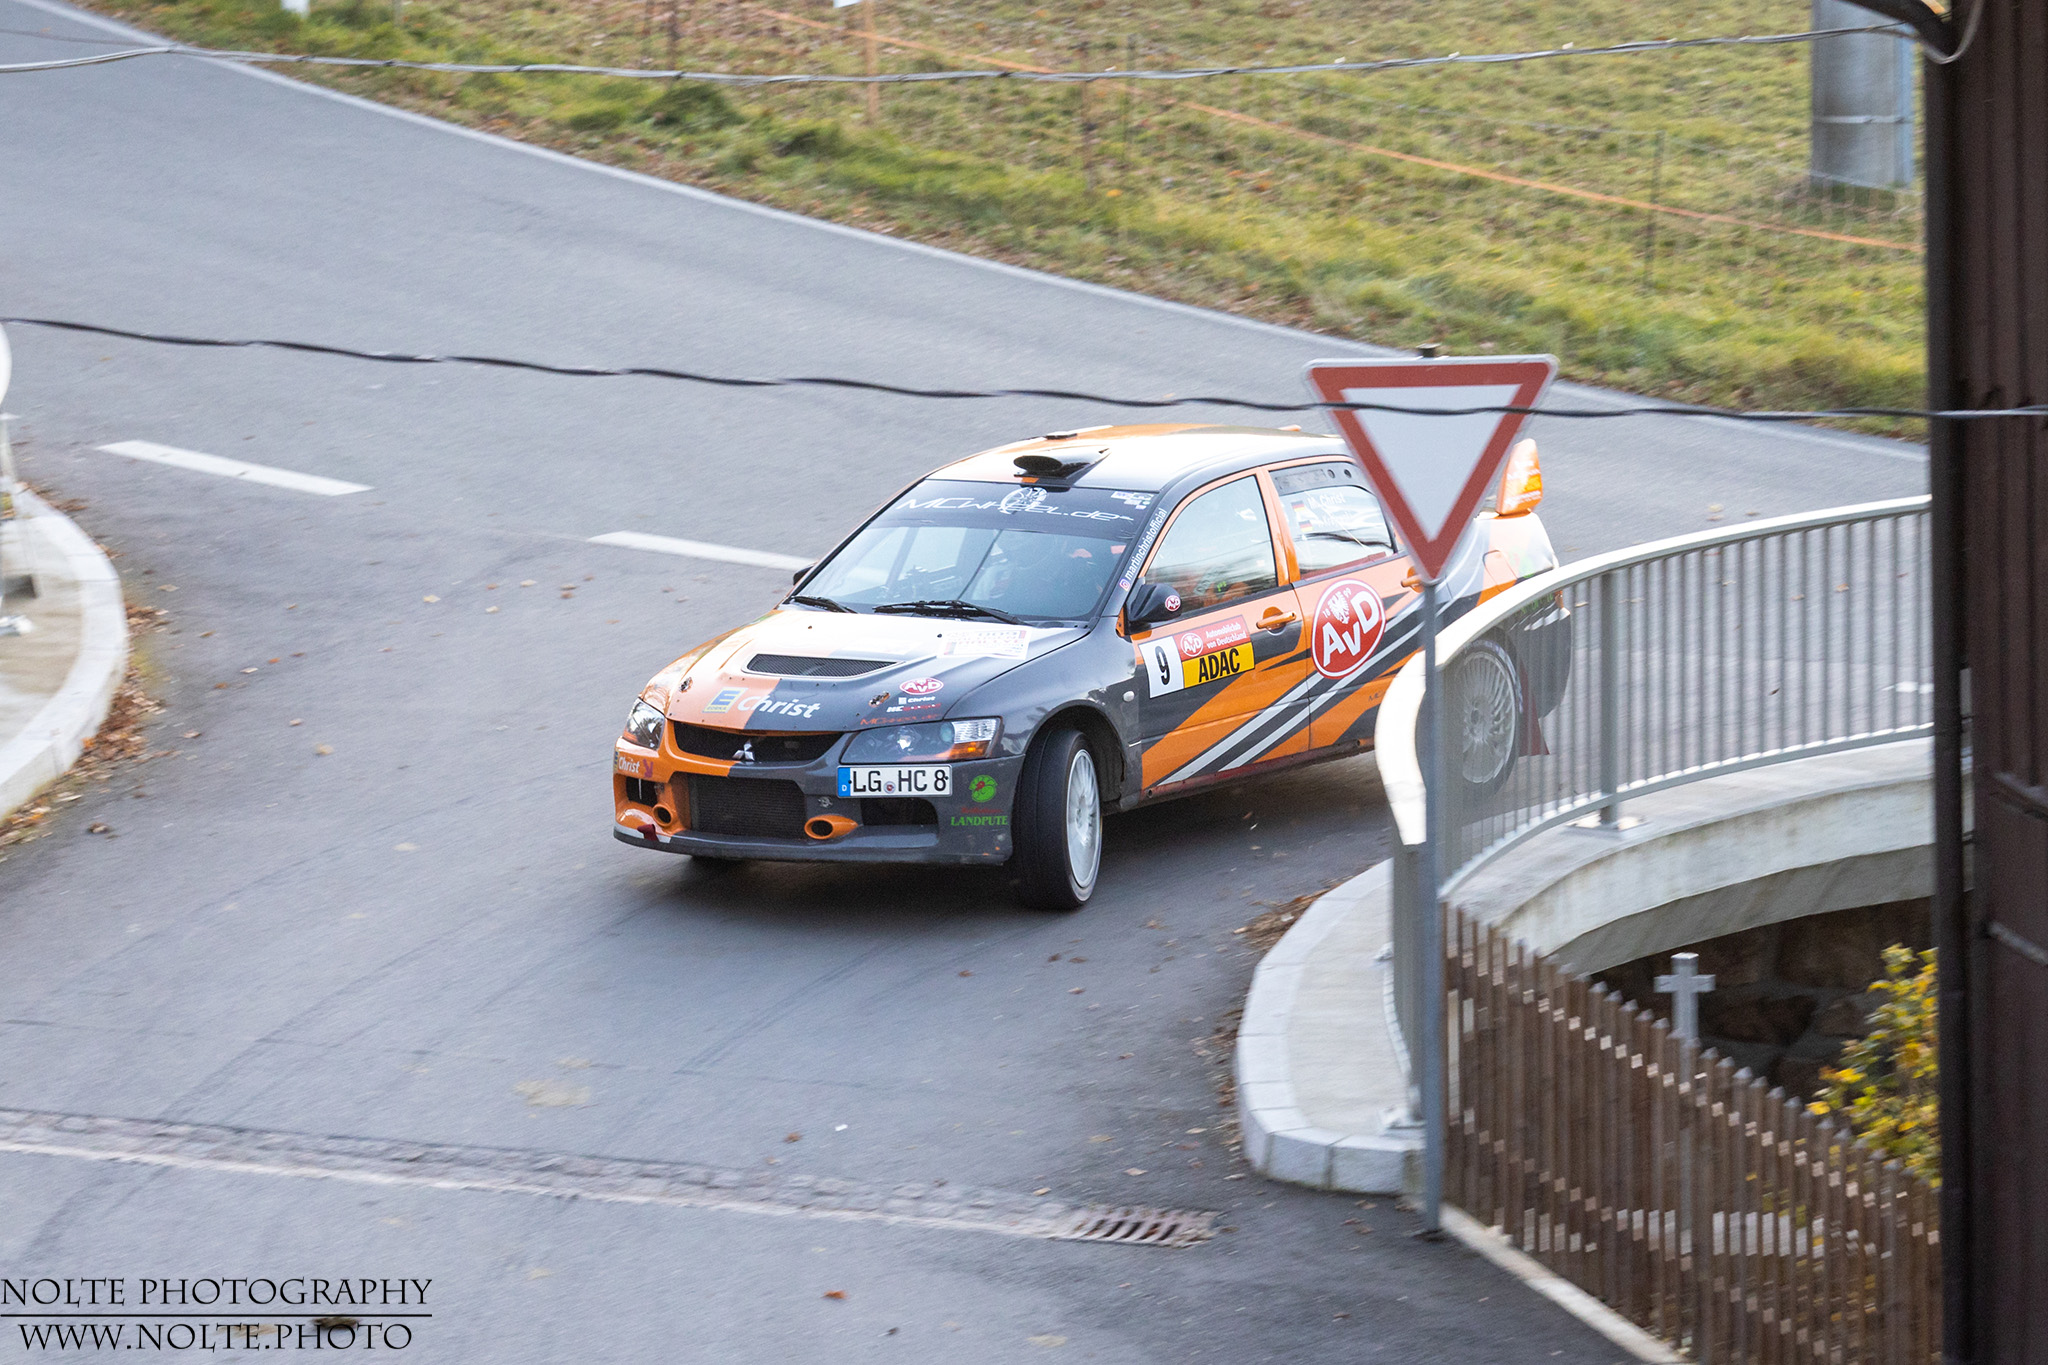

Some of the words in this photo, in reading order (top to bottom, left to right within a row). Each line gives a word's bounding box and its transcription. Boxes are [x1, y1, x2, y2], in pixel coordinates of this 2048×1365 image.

[1205, 622, 1242, 639] Automobilclub
[1322, 590, 1380, 667] AvD
[1183, 639, 1203, 654] AvD
[1217, 630, 1247, 647] Deutschland
[1154, 645, 1171, 686] 9
[1198, 647, 1241, 683] ADAC
[904, 680, 942, 693] AvD
[737, 694, 821, 719] Christ
[618, 756, 640, 774] Christ
[853, 770, 881, 793] LG
[898, 769, 928, 792] HC
[934, 769, 946, 792] 8
[951, 815, 1008, 827] LANDPUTE
